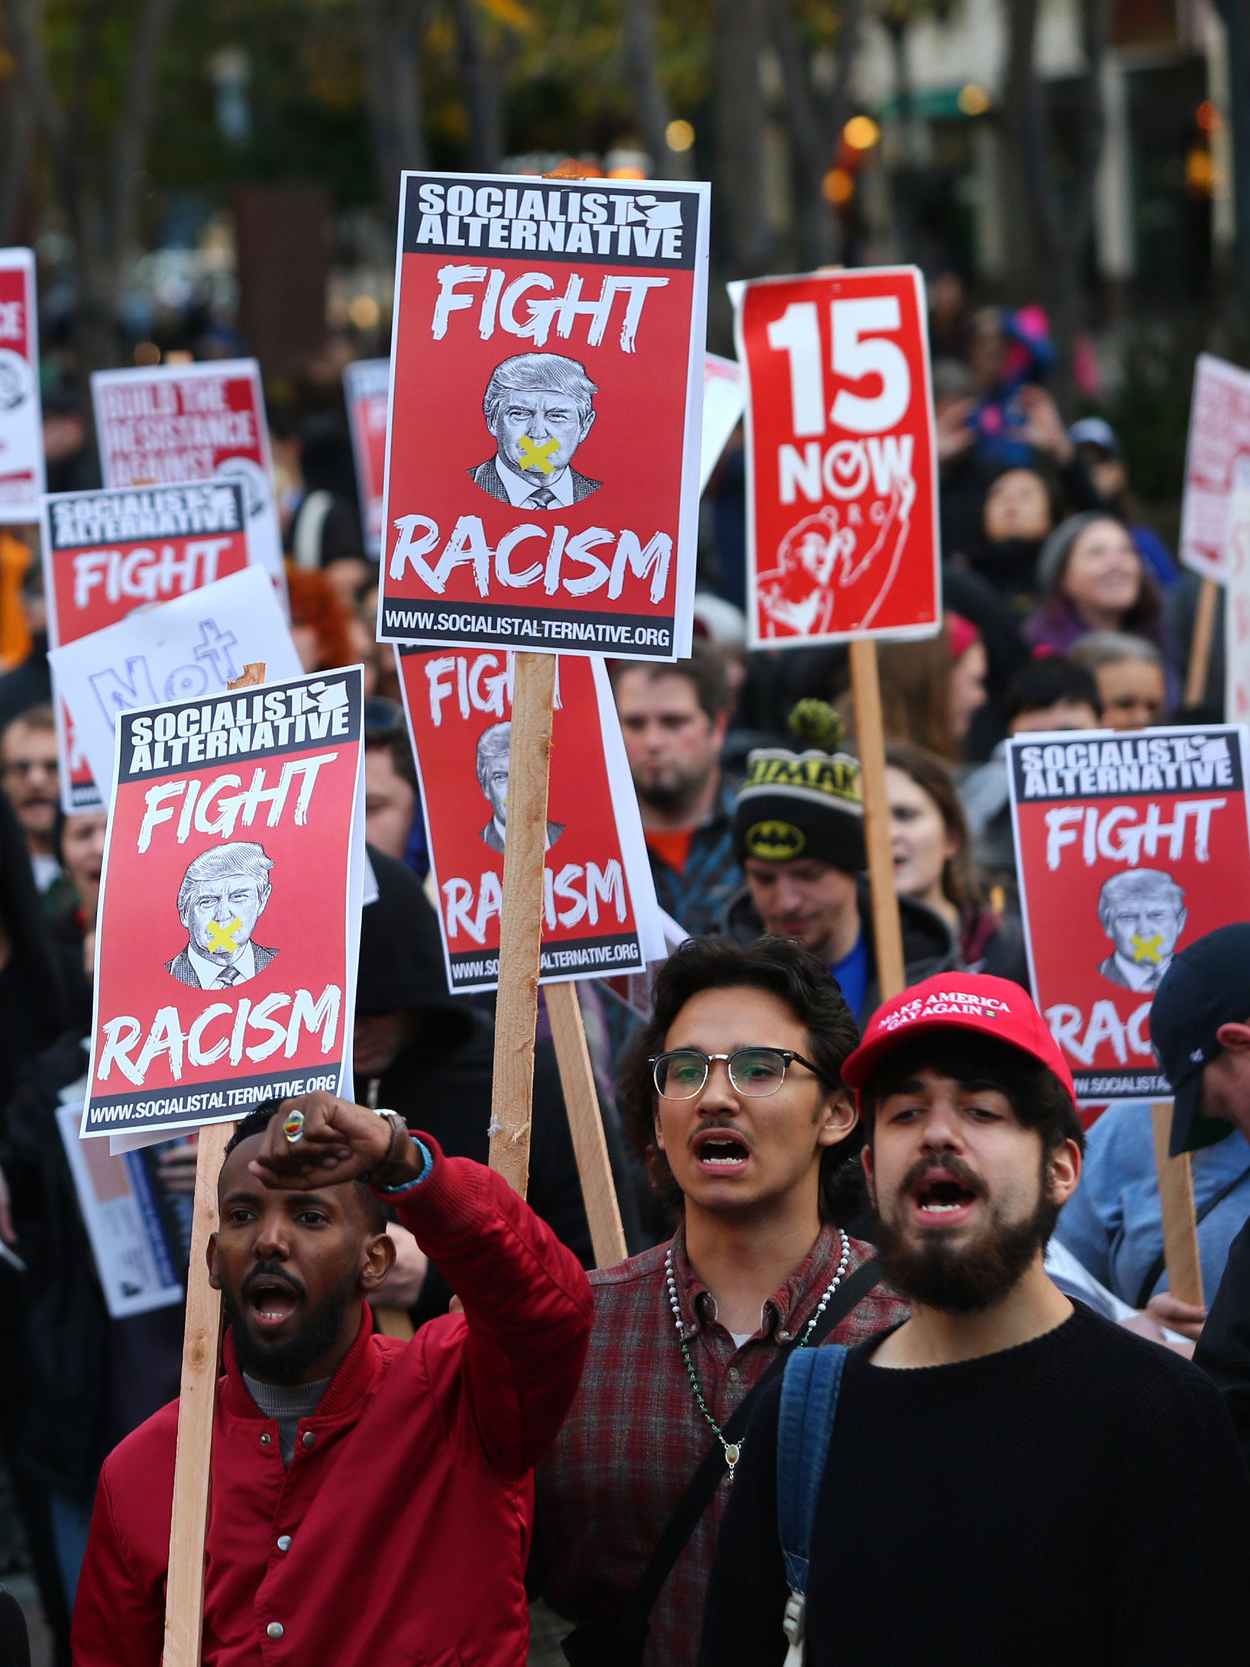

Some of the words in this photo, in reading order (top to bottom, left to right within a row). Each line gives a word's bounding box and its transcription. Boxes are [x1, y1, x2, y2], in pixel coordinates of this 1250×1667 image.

[416, 214, 683, 259] ALTERNATIVE
[418, 184, 634, 225] SOCIALIST
[431, 264, 670, 353] FIGHT
[767, 296, 911, 438] 15
[778, 435, 914, 504] NOW
[55, 504, 239, 546] ALTERNATIVE
[73, 538, 231, 607] FIGHT
[389, 513, 673, 604] RACISM
[385, 610, 670, 647] WWW.SOCIALISTALTERNATIVE.ORG
[128, 705, 350, 774] ALTERNATIVE
[131, 687, 306, 748] SOCIALIST
[1021, 738, 1186, 774] SOCIALIST
[1023, 758, 1233, 798] ALTERNATIVE
[137, 751, 339, 854] FIGHT
[1044, 799, 1228, 871] FIGHT
[442, 859, 627, 944] RAISM
[96, 984, 342, 1086] RACISM
[878, 998, 922, 1030] MAKE
[925, 992, 1011, 1013] AMERICA
[887, 1007, 921, 1031] GAY
[921, 1003, 982, 1020] AGAIN
[1045, 999, 1152, 1065] RAC
[90, 1074, 337, 1124] WWW.SOCIALISTALTERNATIVE.ORG
